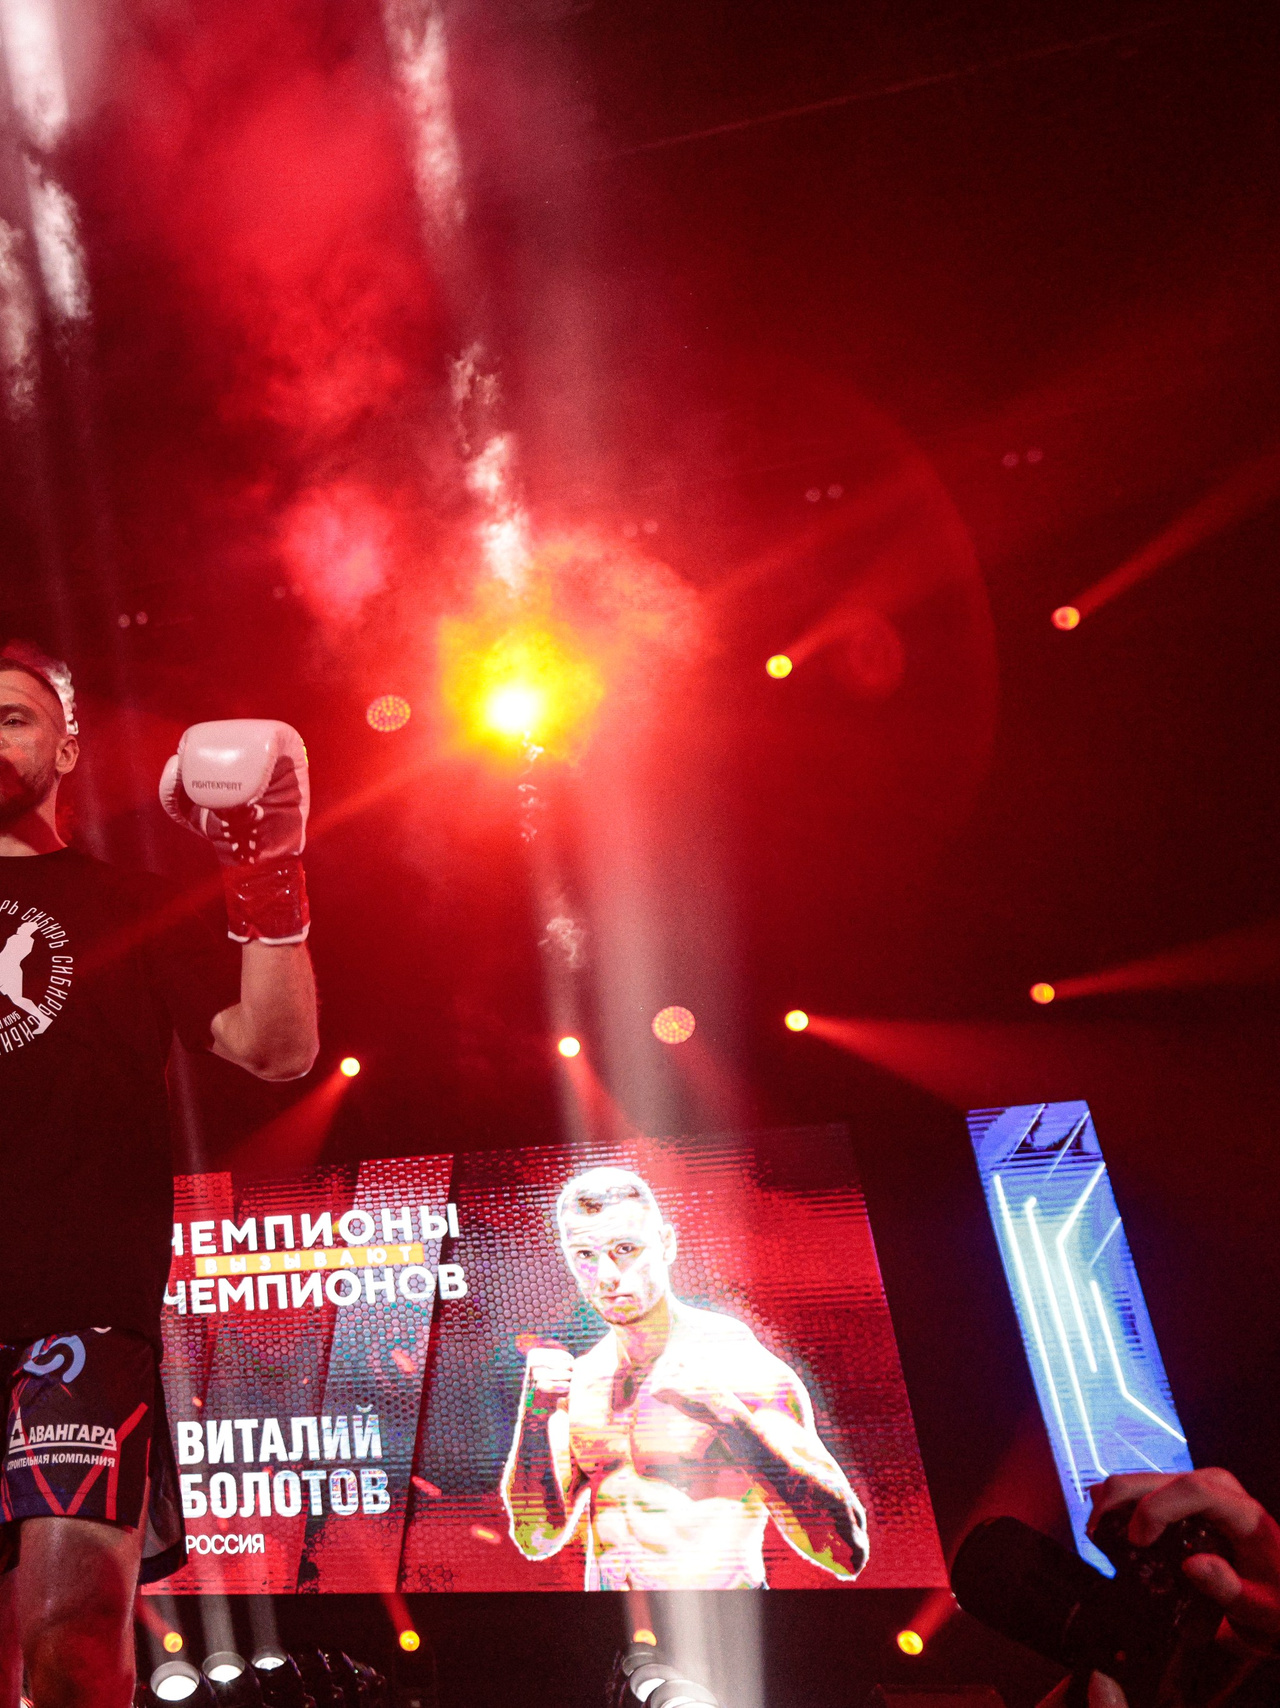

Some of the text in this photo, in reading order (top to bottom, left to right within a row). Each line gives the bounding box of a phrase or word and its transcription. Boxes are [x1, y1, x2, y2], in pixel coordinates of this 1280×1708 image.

[38, 955, 74, 1018] СИБИРЬ
[2, 1010, 22, 1027] КЛУБ
[204, 1246, 413, 1275] ВЫЗЫВАЮТ
[163, 1263, 468, 1315] ЧЕМПИОНОВ
[28, 1424, 118, 1451] АВАНГАРД
[177, 1403, 383, 1465] ВИТАЛИЙ
[51, 1453, 116, 1468] КОМПАНИЯ
[179, 1468, 391, 1519] БОЛОТОВ
[185, 1533, 266, 1555] РОССИЯ
